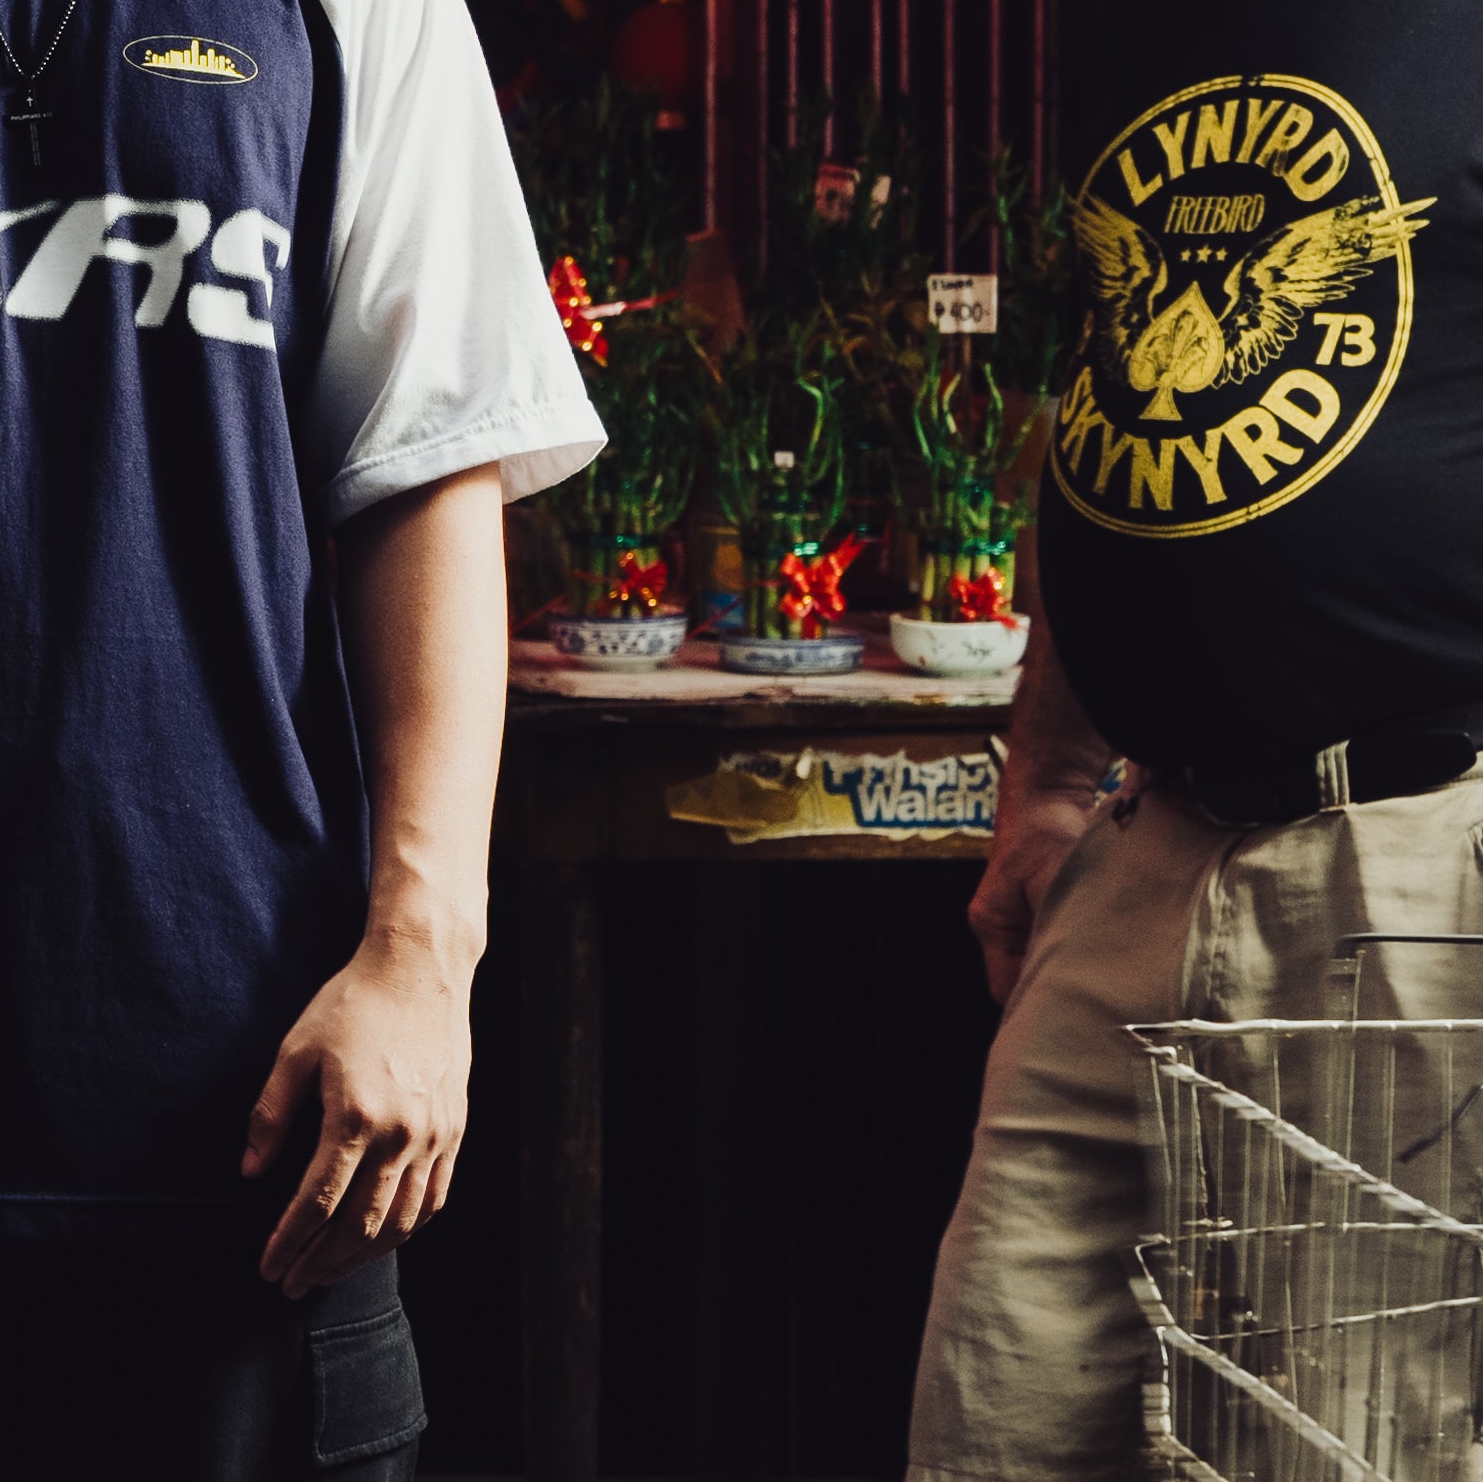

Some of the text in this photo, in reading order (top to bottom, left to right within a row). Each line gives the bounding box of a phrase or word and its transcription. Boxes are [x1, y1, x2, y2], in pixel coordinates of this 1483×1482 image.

[1118, 98, 1350, 207] LYNYRD
[1164, 194, 1266, 235] FREEBIRD
[1313, 312, 1377, 367] 73
[1060, 367, 1341, 511] SKYNYRD
